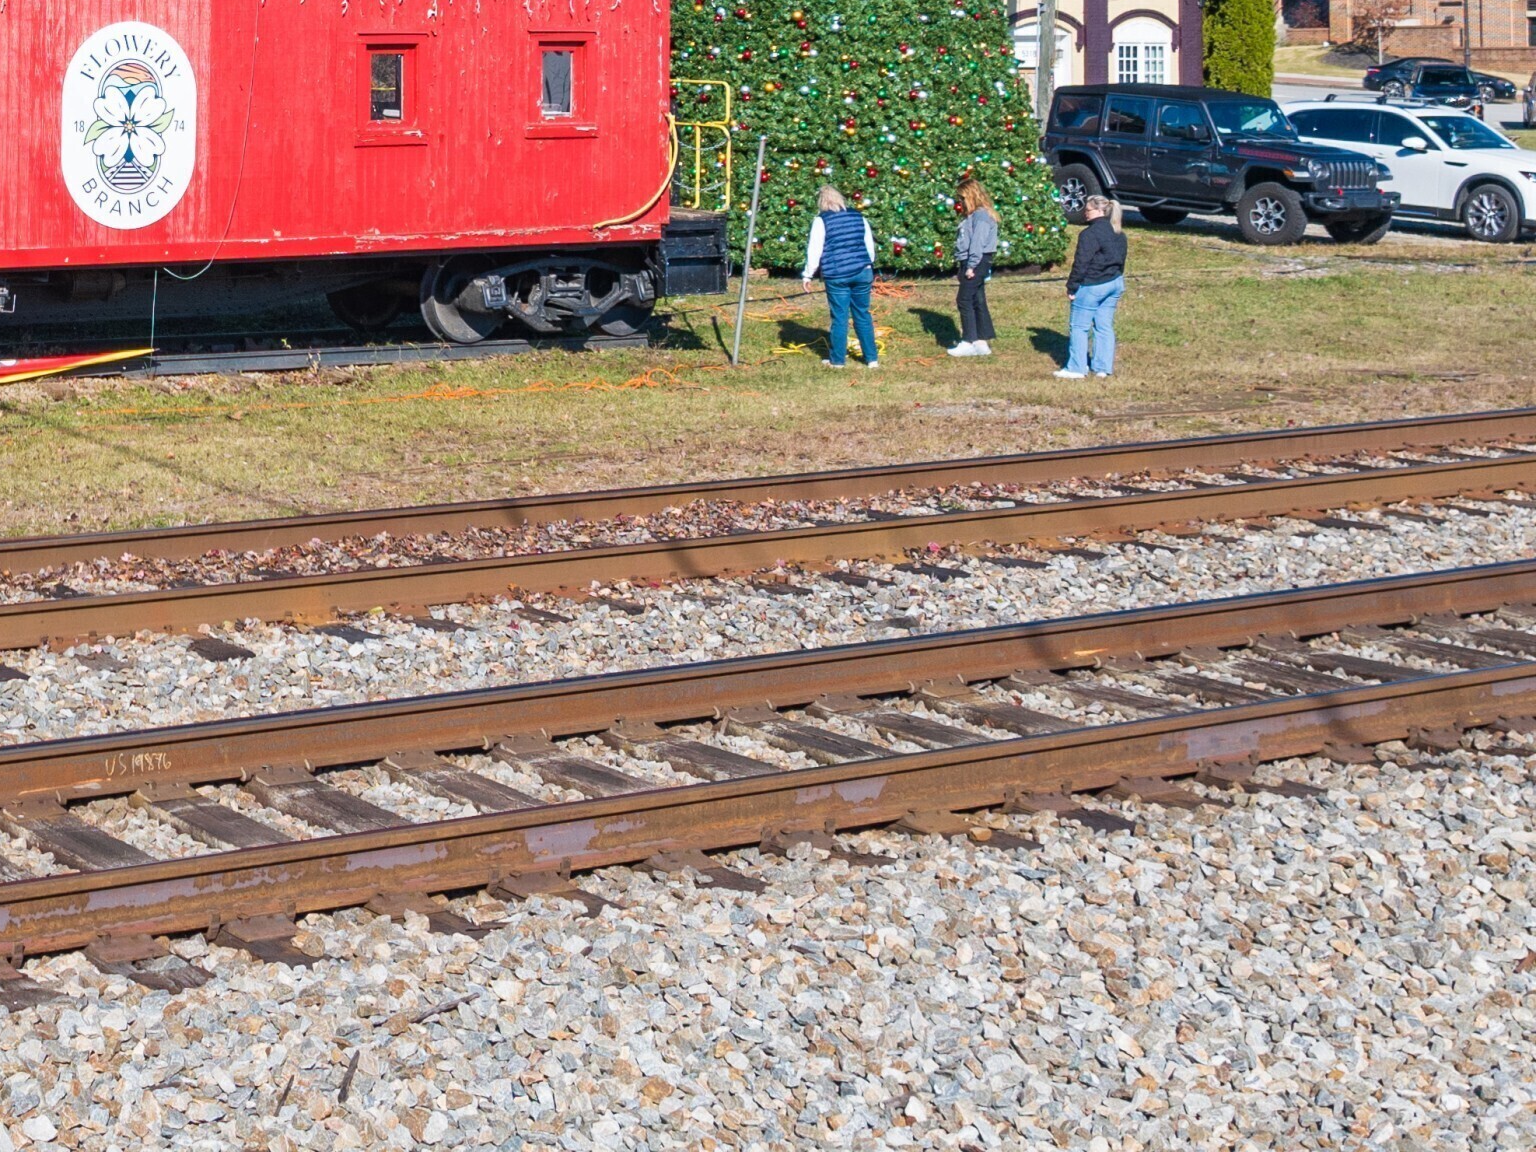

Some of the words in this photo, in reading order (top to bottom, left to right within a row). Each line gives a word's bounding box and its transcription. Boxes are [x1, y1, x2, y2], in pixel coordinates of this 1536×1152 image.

[80, 34, 182, 80] FLOWERY
[73, 120, 85, 133] 18
[173, 120, 185, 133] 74
[82, 177, 174, 216] BRANCH
